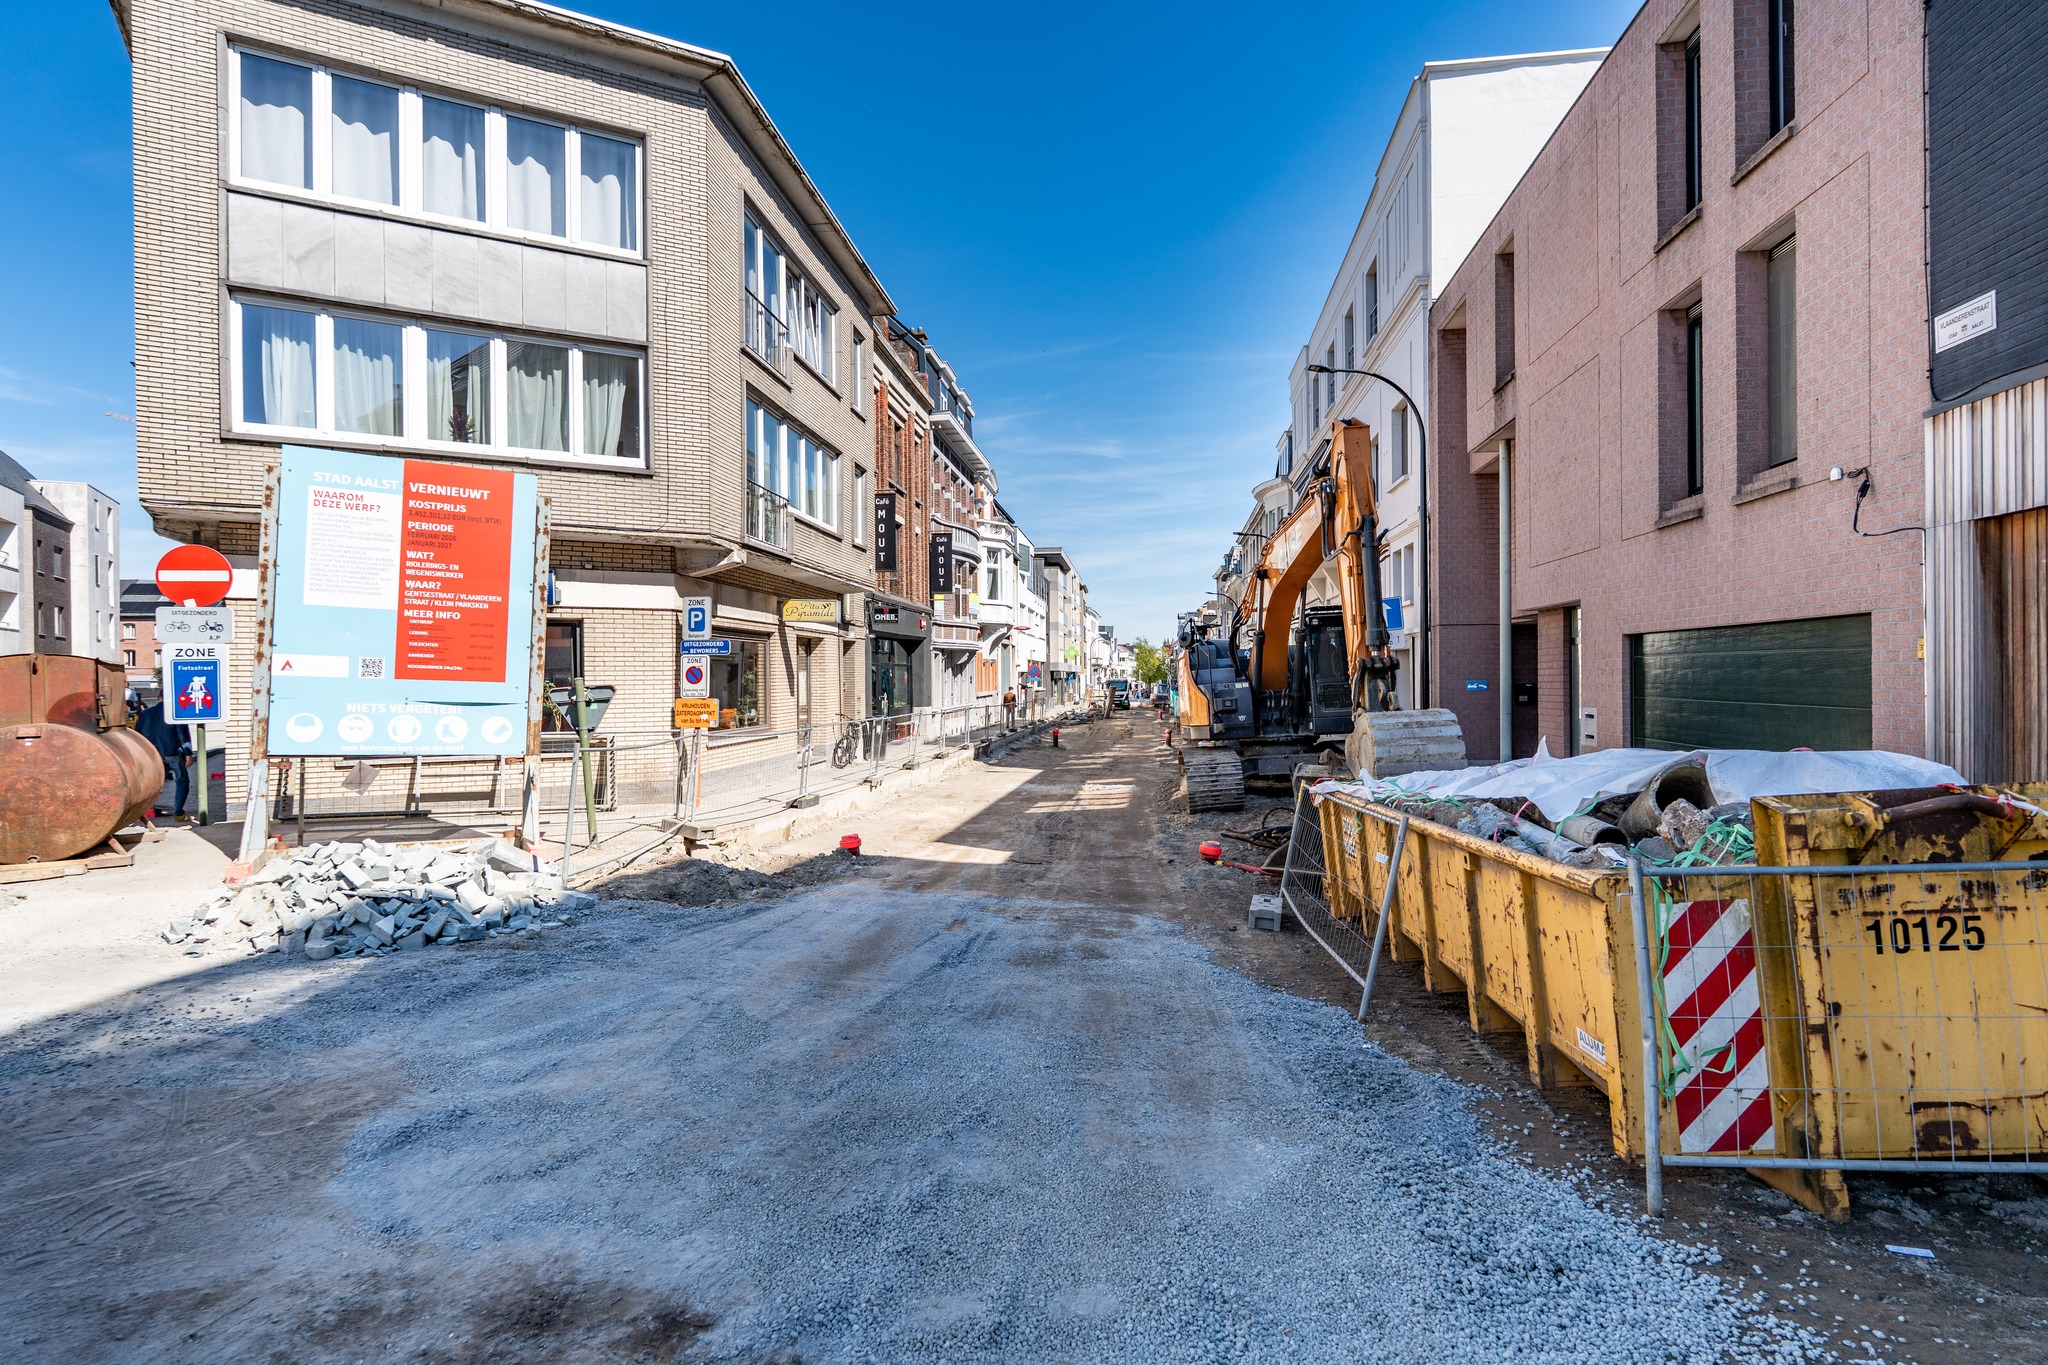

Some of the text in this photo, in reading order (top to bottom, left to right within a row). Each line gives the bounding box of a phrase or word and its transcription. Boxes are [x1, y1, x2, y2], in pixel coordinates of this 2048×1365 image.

[1940, 302, 1990, 329] VLAANDERENSTRAAT
[313, 471, 399, 490] STAD AALST
[313, 490, 364, 502] WAAROM
[409, 482, 490, 500] VERNIEUWT
[313, 499, 381, 513] DEZE WERF?
[408, 499, 467, 513] KOSTPRIJS
[876, 497, 890, 505] Café
[407, 521, 454, 533] PERIODE
[407, 531, 440, 540] FEBRUARI
[878, 510, 886, 562] MOUT
[407, 539, 436, 548] JANUARI
[406, 550, 435, 561] WAT?
[405, 560, 448, 570] RIOLERINGS-
[405, 568, 464, 579] WEGENISWERKEN
[405, 580, 441, 590] WAAR?
[404, 590, 455, 599] GENTSESTRAAT
[460, 594, 502, 603] VLAANDEREN
[404, 598, 429, 606] STRAAT
[434, 600, 454, 608] KLEIN
[455, 602, 489, 610] PARKSKEN
[403, 609, 461, 620] MEER INFO
[785, 606, 834, 621] Pyramide
[690, 611, 703, 629] P
[175, 648, 216, 658] ZONE
[346, 703, 462, 715] NIETS VERGETEN!
[340, 744, 359, 752] ook
[360, 744, 414, 752] leveranciers
[432, 744, 444, 752] de
[445, 744, 465, 752] werf
[1865, 914, 1985, 955] 10125
